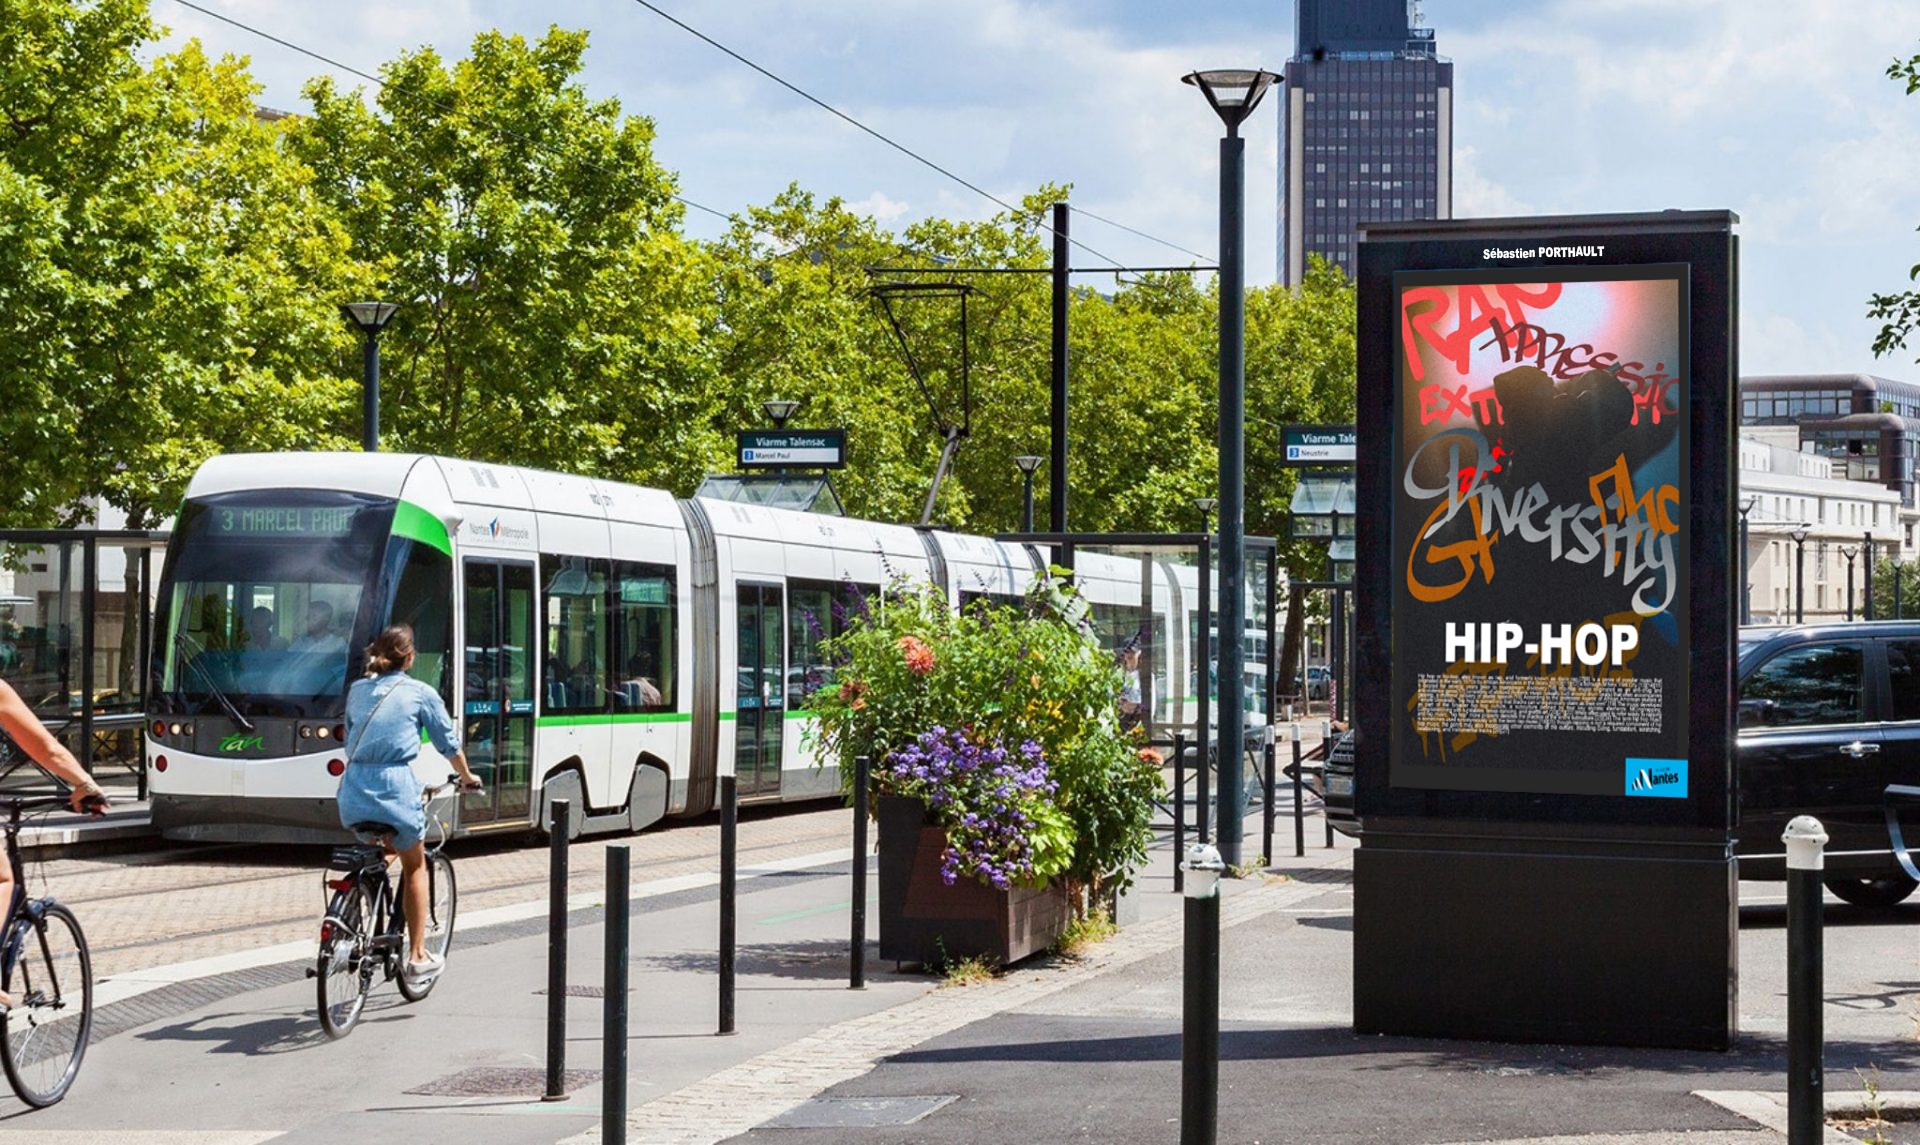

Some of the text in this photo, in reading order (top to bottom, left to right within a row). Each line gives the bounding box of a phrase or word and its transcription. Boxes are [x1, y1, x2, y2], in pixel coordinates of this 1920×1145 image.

[1483, 246, 1605, 260] Sébastien PORTHAULT
[756, 437, 826, 447] Viarme Talensac
[1301, 434, 1337, 444] Viarme
[776, 452, 791, 460] Paul
[1301, 449, 1329, 457] Neustrie
[222, 509, 234, 532] 3
[242, 509, 305, 532] MARCEL
[1445, 622, 1639, 666] HIP-HOP
[218, 732, 267, 752] tan
[1631, 767, 1679, 791] Nantes
